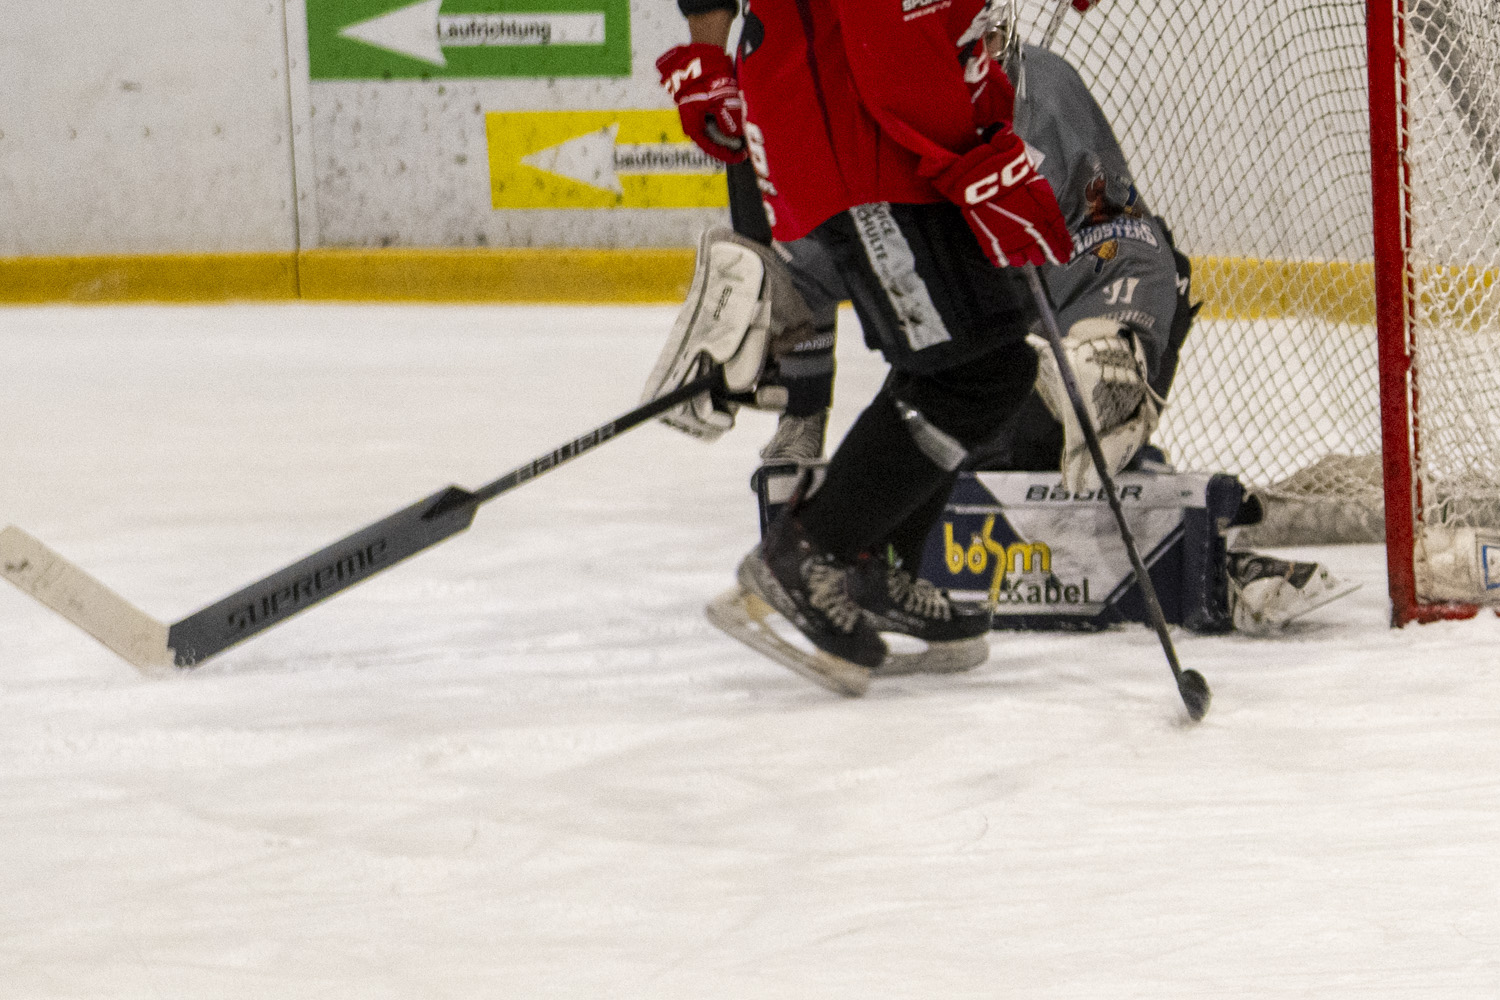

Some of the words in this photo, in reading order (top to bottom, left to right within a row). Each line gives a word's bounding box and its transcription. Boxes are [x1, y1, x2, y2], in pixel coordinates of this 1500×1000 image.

[436, 20, 551, 44] Laufrichtung
[965, 146, 1035, 205] CC
[1004, 577, 1090, 604] Kabel
